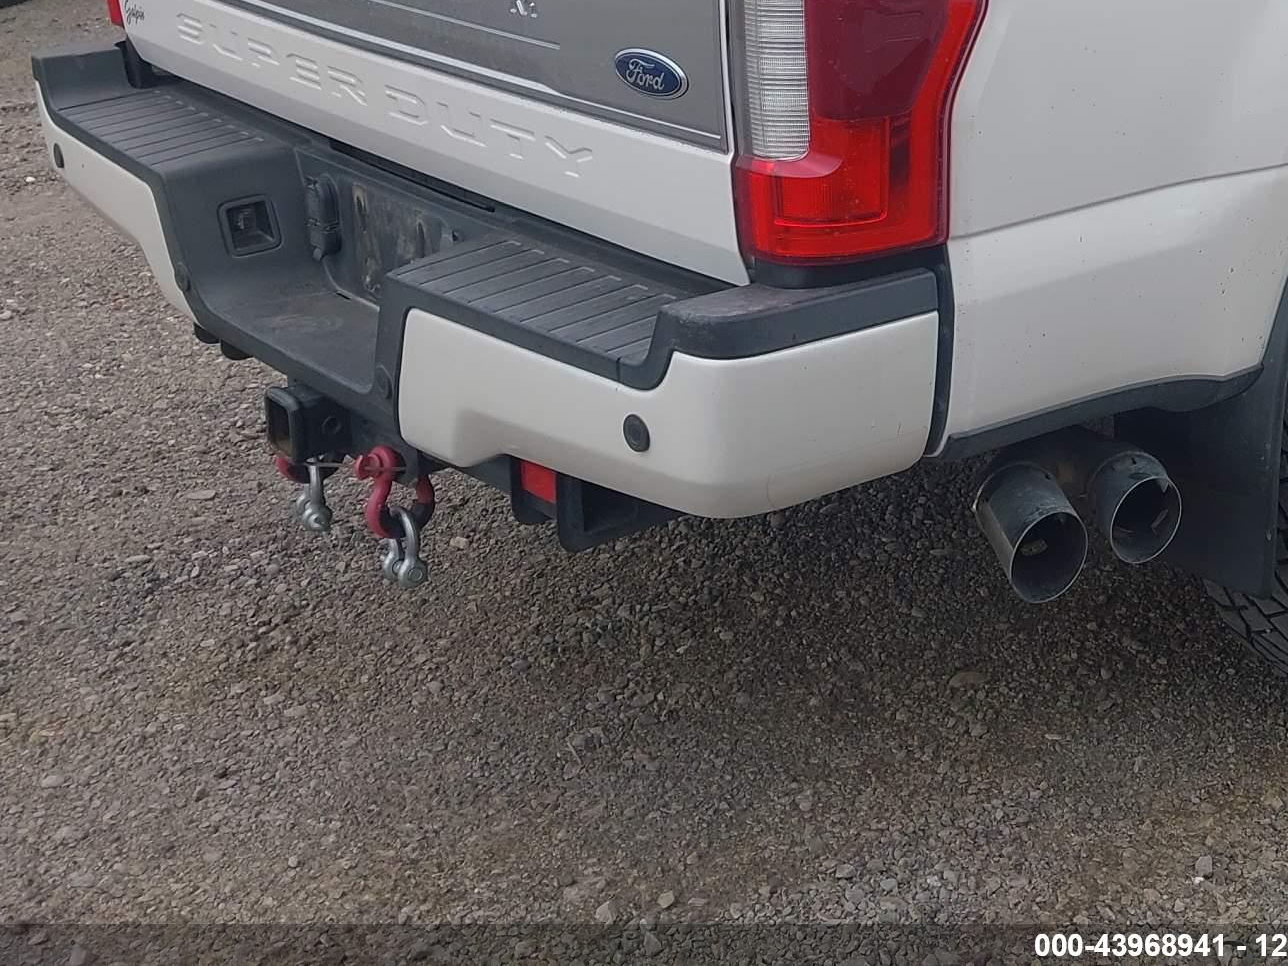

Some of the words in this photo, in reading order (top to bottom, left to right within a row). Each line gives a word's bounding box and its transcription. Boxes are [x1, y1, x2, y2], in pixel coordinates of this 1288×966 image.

[176, 12, 369, 108] SUPER
[383, 83, 594, 179] DUTY
[626, 57, 666, 91] Ford
